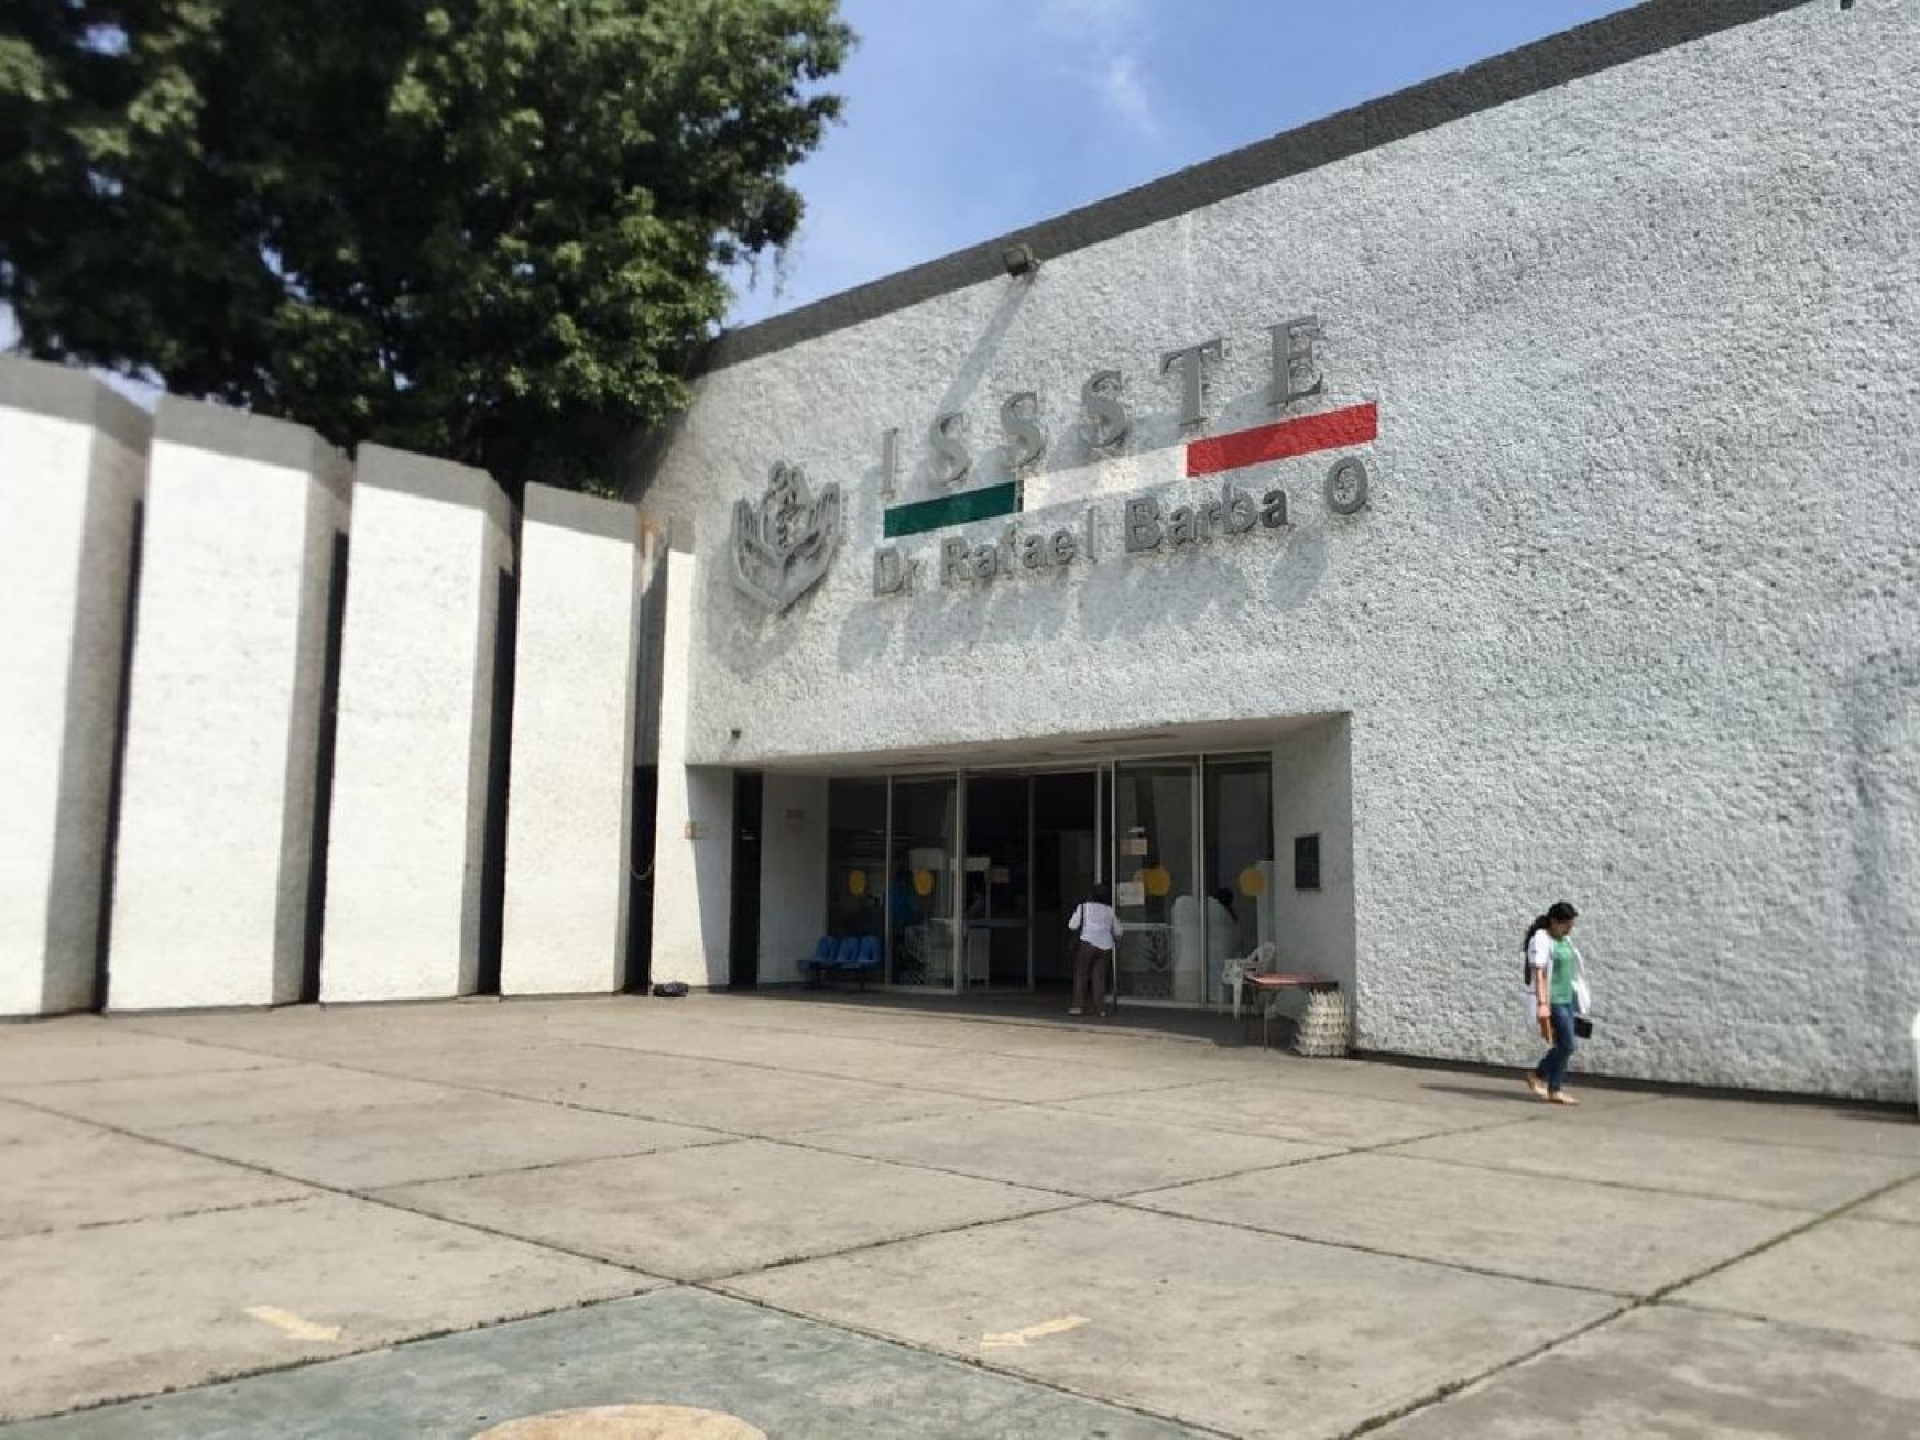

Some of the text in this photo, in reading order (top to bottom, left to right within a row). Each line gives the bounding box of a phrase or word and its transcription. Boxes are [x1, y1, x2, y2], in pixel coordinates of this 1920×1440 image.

[881, 315, 1324, 500] ISSSTE
[940, 506, 1099, 588] Rafael
[1124, 482, 1290, 552] Barba
